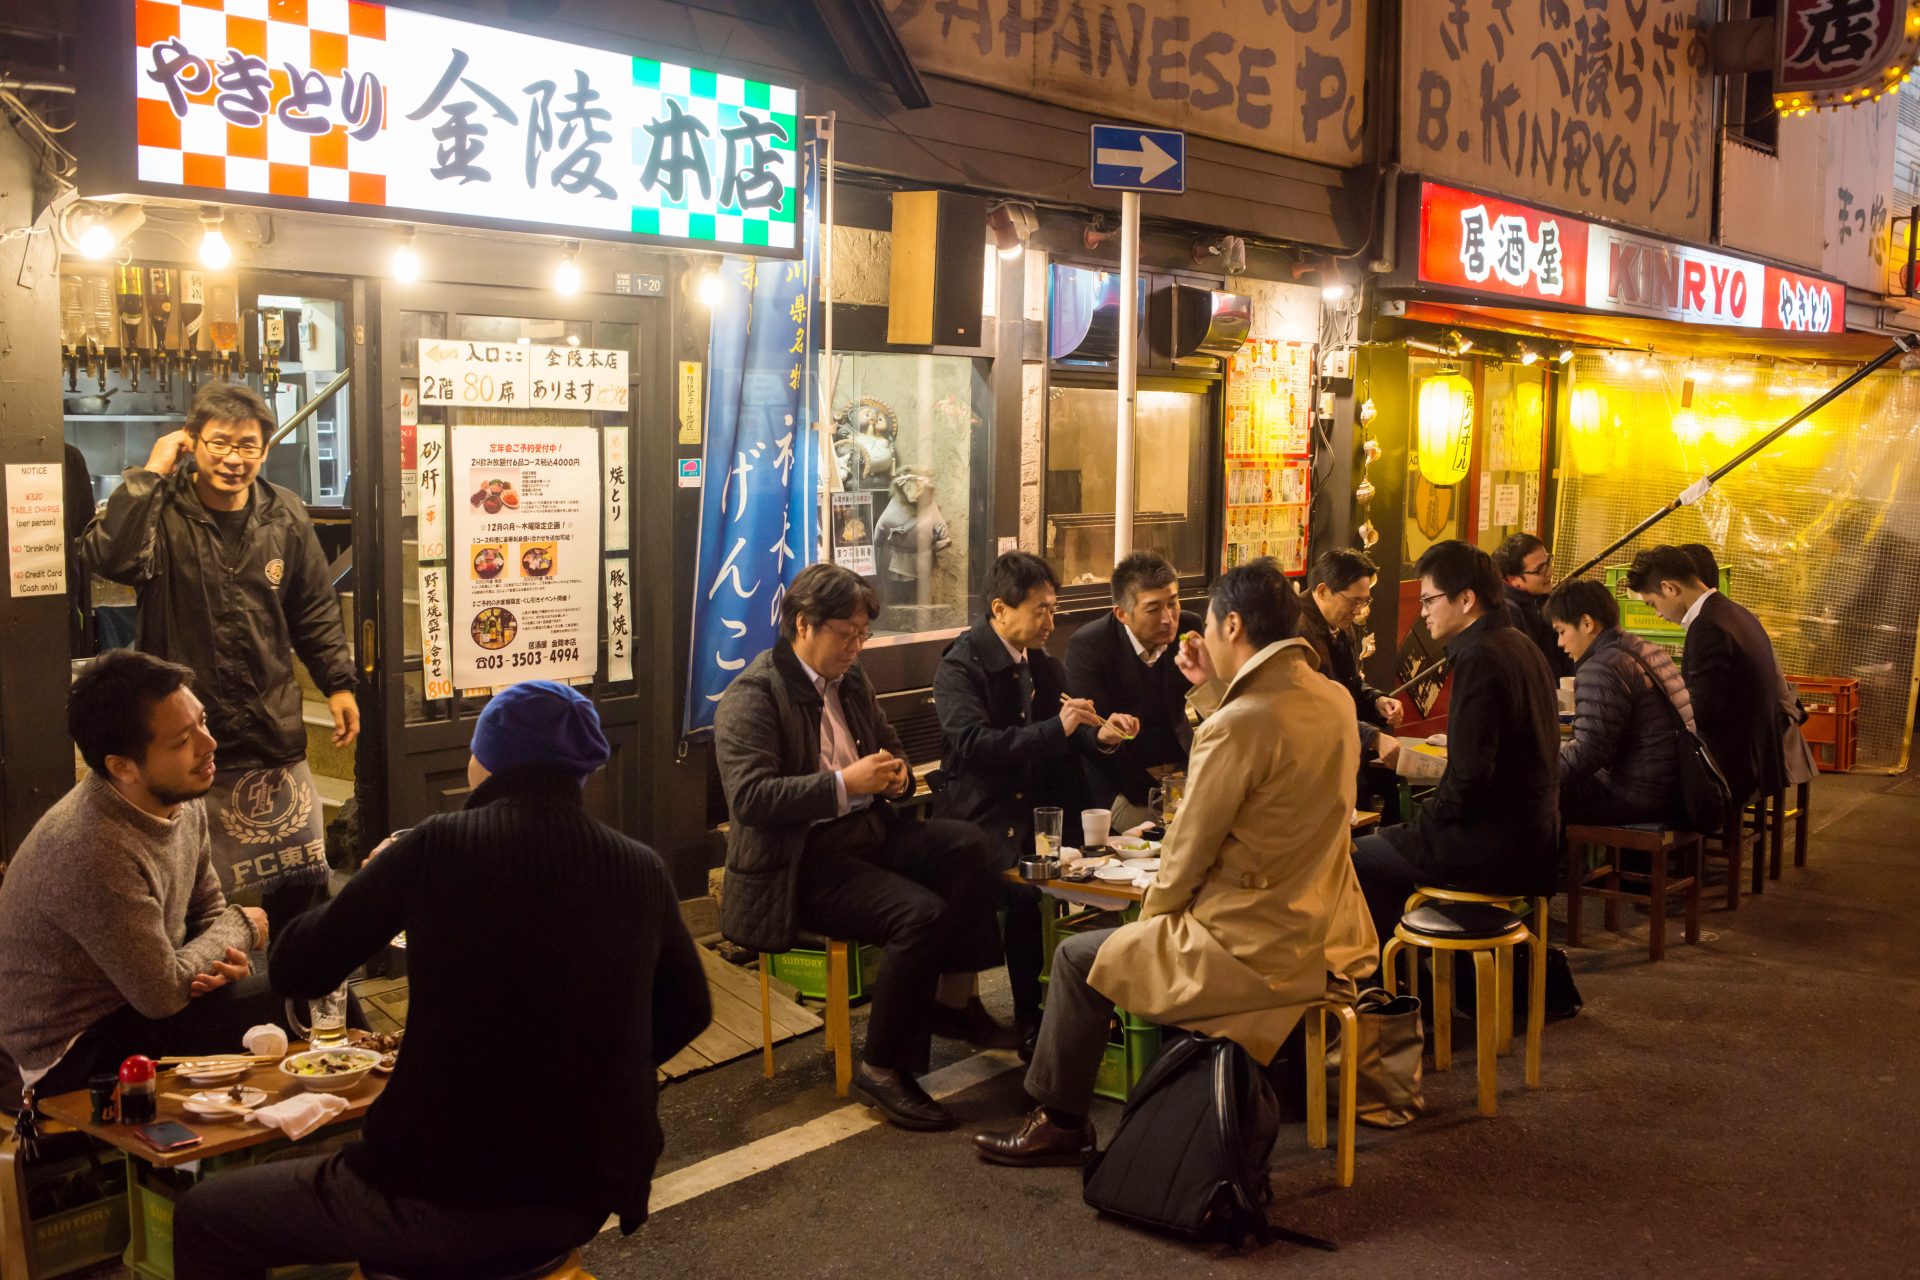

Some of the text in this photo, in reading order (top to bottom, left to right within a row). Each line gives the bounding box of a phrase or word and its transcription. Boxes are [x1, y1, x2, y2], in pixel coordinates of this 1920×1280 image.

[1792, 0, 1873, 64] 店
[144, 36, 790, 213] やきとり 金陵本店
[1480, 59, 1637, 205] KINRYO
[1461, 205, 1562, 295] 居酒屋
[637, 278, 661, 292] 1-20
[1608, 237, 1748, 321] KINRYO
[1778, 277, 1832, 333] やきとり
[423, 376, 454, 400] 2階
[533, 378, 595, 404] あります
[21, 466, 48, 475] NOTICE
[420, 440, 442, 498] 砂肝
[609, 465, 626, 522] 焼とり
[11, 505, 61, 514] TABLE CHARGE
[16, 517, 56, 528] (per person)
[421, 543, 444, 559] 160
[19, 581, 58, 593] (Cash only)
[25, 571, 45, 579] Credit
[47, 570, 63, 578] Card
[423, 572, 443, 679] 野菜焼盛り合わせ
[609, 568, 629, 659] 豚串焼き
[488, 647, 579, 670] 03-3503-4994
[528, 640, 548, 650] 居酒屋
[428, 677, 451, 700] 810
[231, 838, 325, 886] FC東京
[782, 956, 823, 968] SUNTORY
